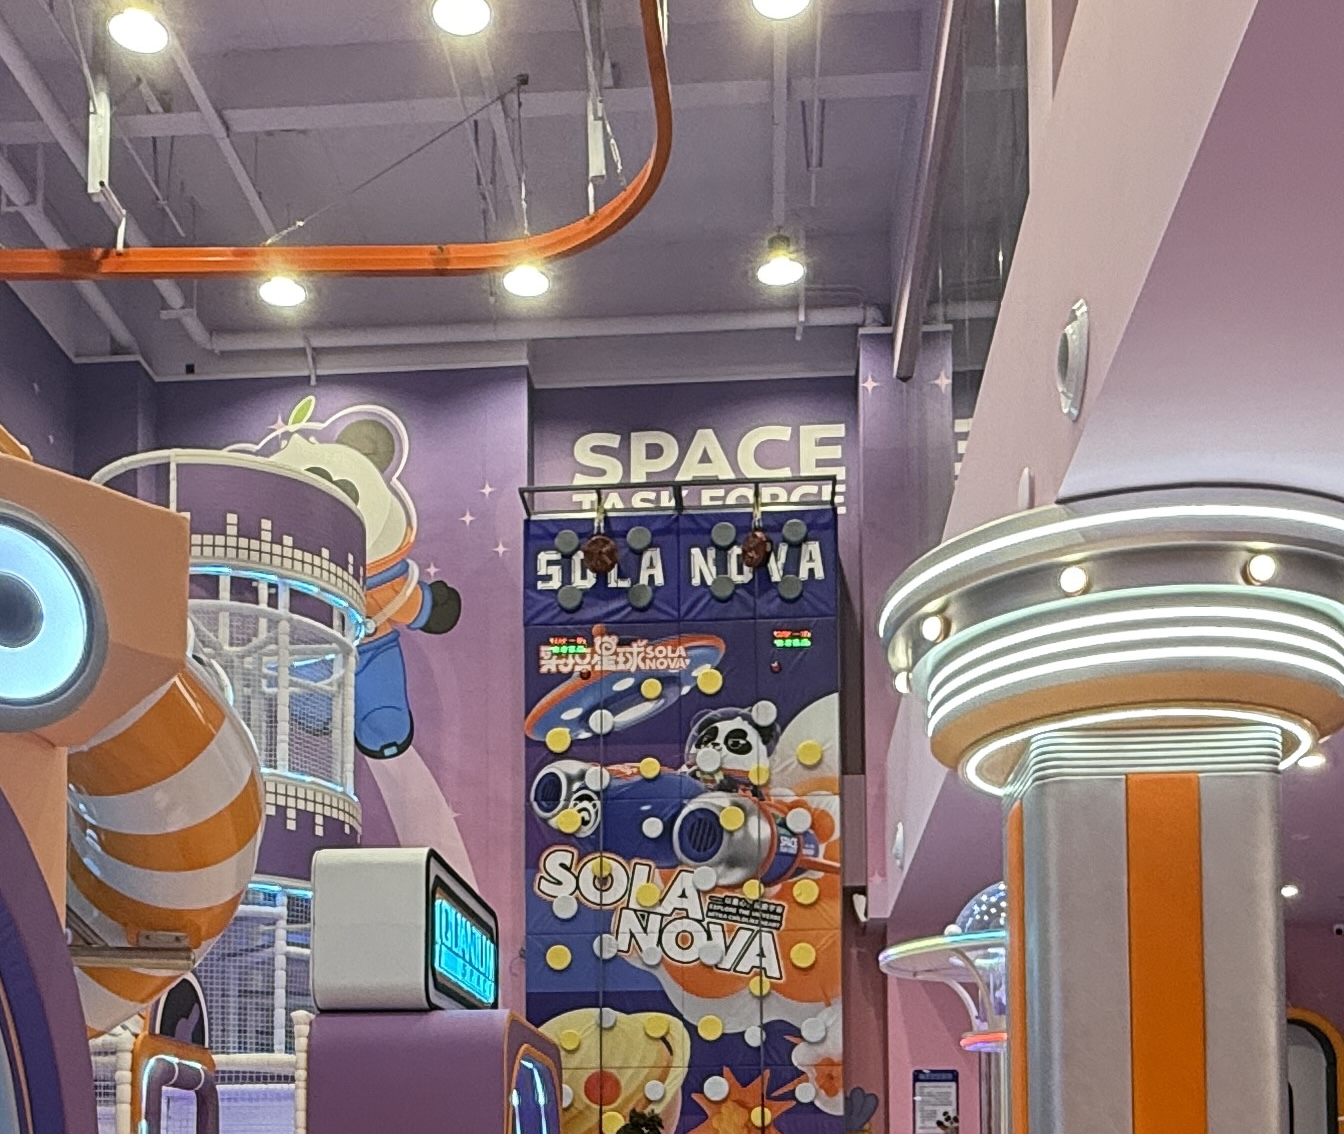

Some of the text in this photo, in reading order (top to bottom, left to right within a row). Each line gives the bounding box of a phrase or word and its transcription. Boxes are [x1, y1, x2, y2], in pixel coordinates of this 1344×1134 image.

[572, 424, 846, 486] SPACE
[572, 483, 847, 515] TASK FORCE
[537, 540, 825, 590] SOLA NOVA
[645, 645, 687, 658] SOLA
[645, 658, 688, 670] NOVA
[537, 849, 705, 922] SOLA
[615, 907, 784, 981] NOVA
